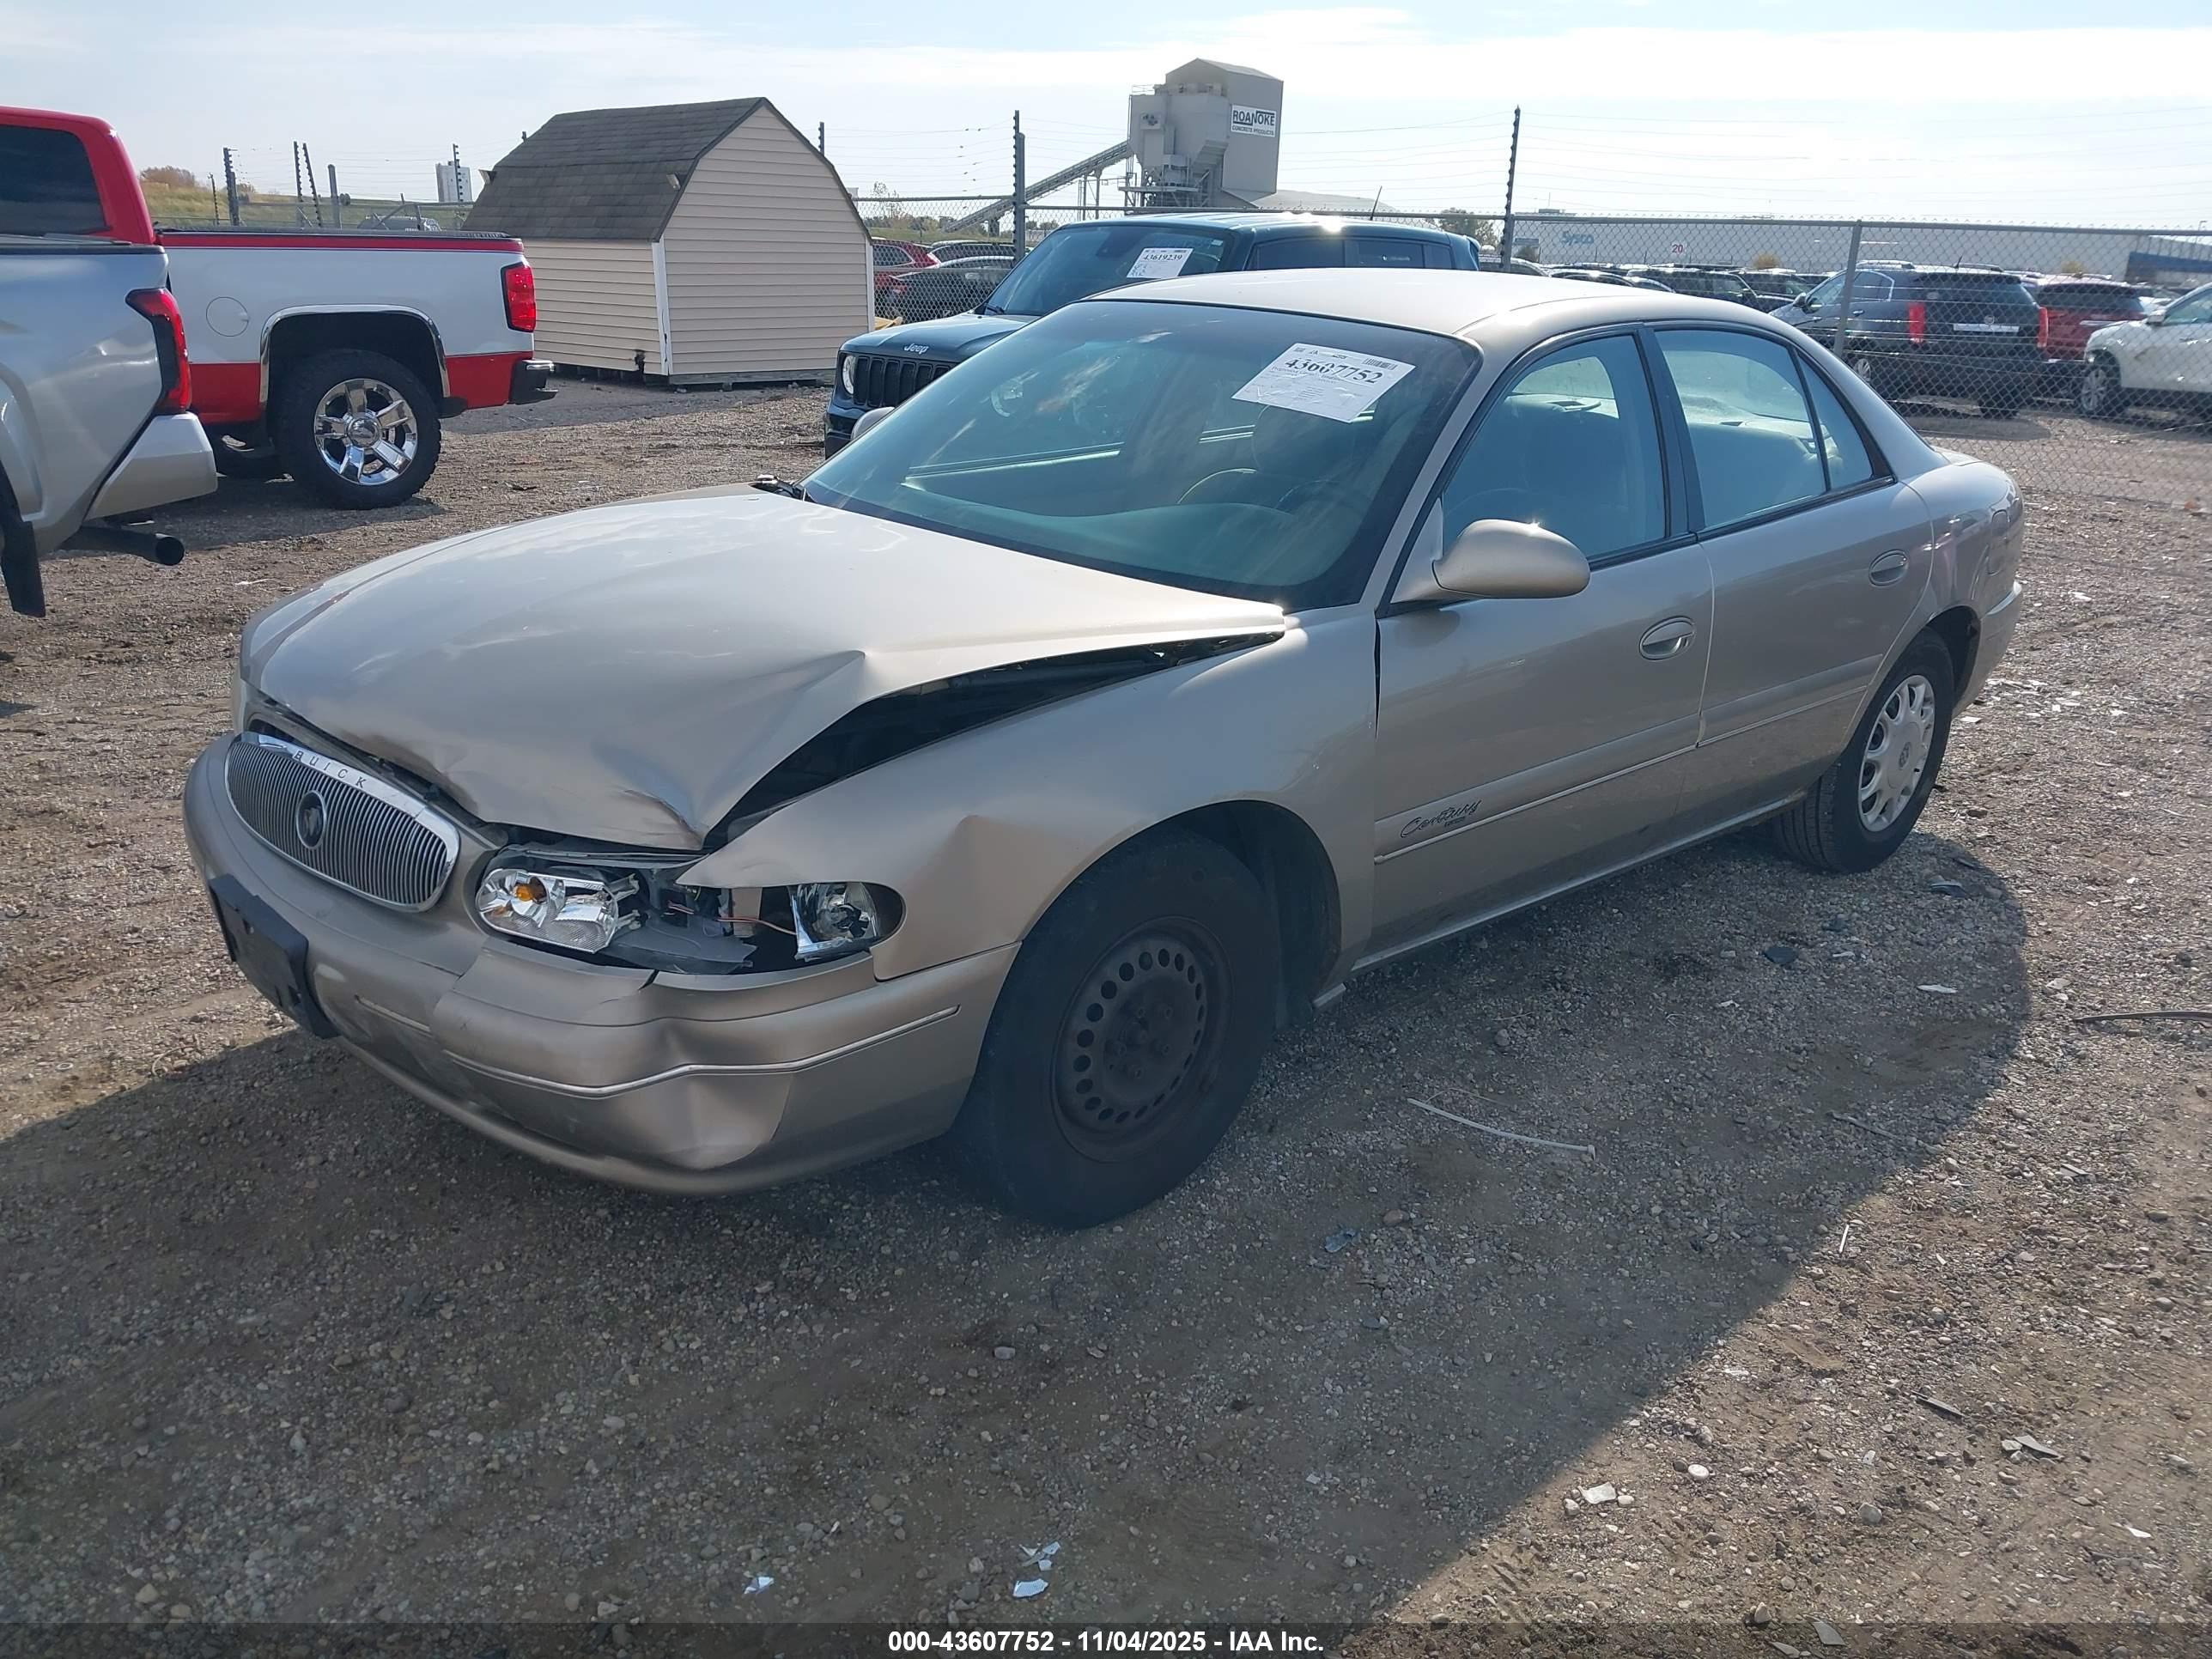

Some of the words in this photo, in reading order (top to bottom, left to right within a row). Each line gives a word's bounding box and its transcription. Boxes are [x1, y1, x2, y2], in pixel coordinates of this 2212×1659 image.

[1232, 109, 1275, 126] ROANOKE
[1671, 244, 1684, 254] 20
[1144, 253, 1182, 262] 43619239
[903, 343, 929, 355] Jeep
[294, 750, 367, 789] BUICK
[1400, 799, 1482, 839] Century
